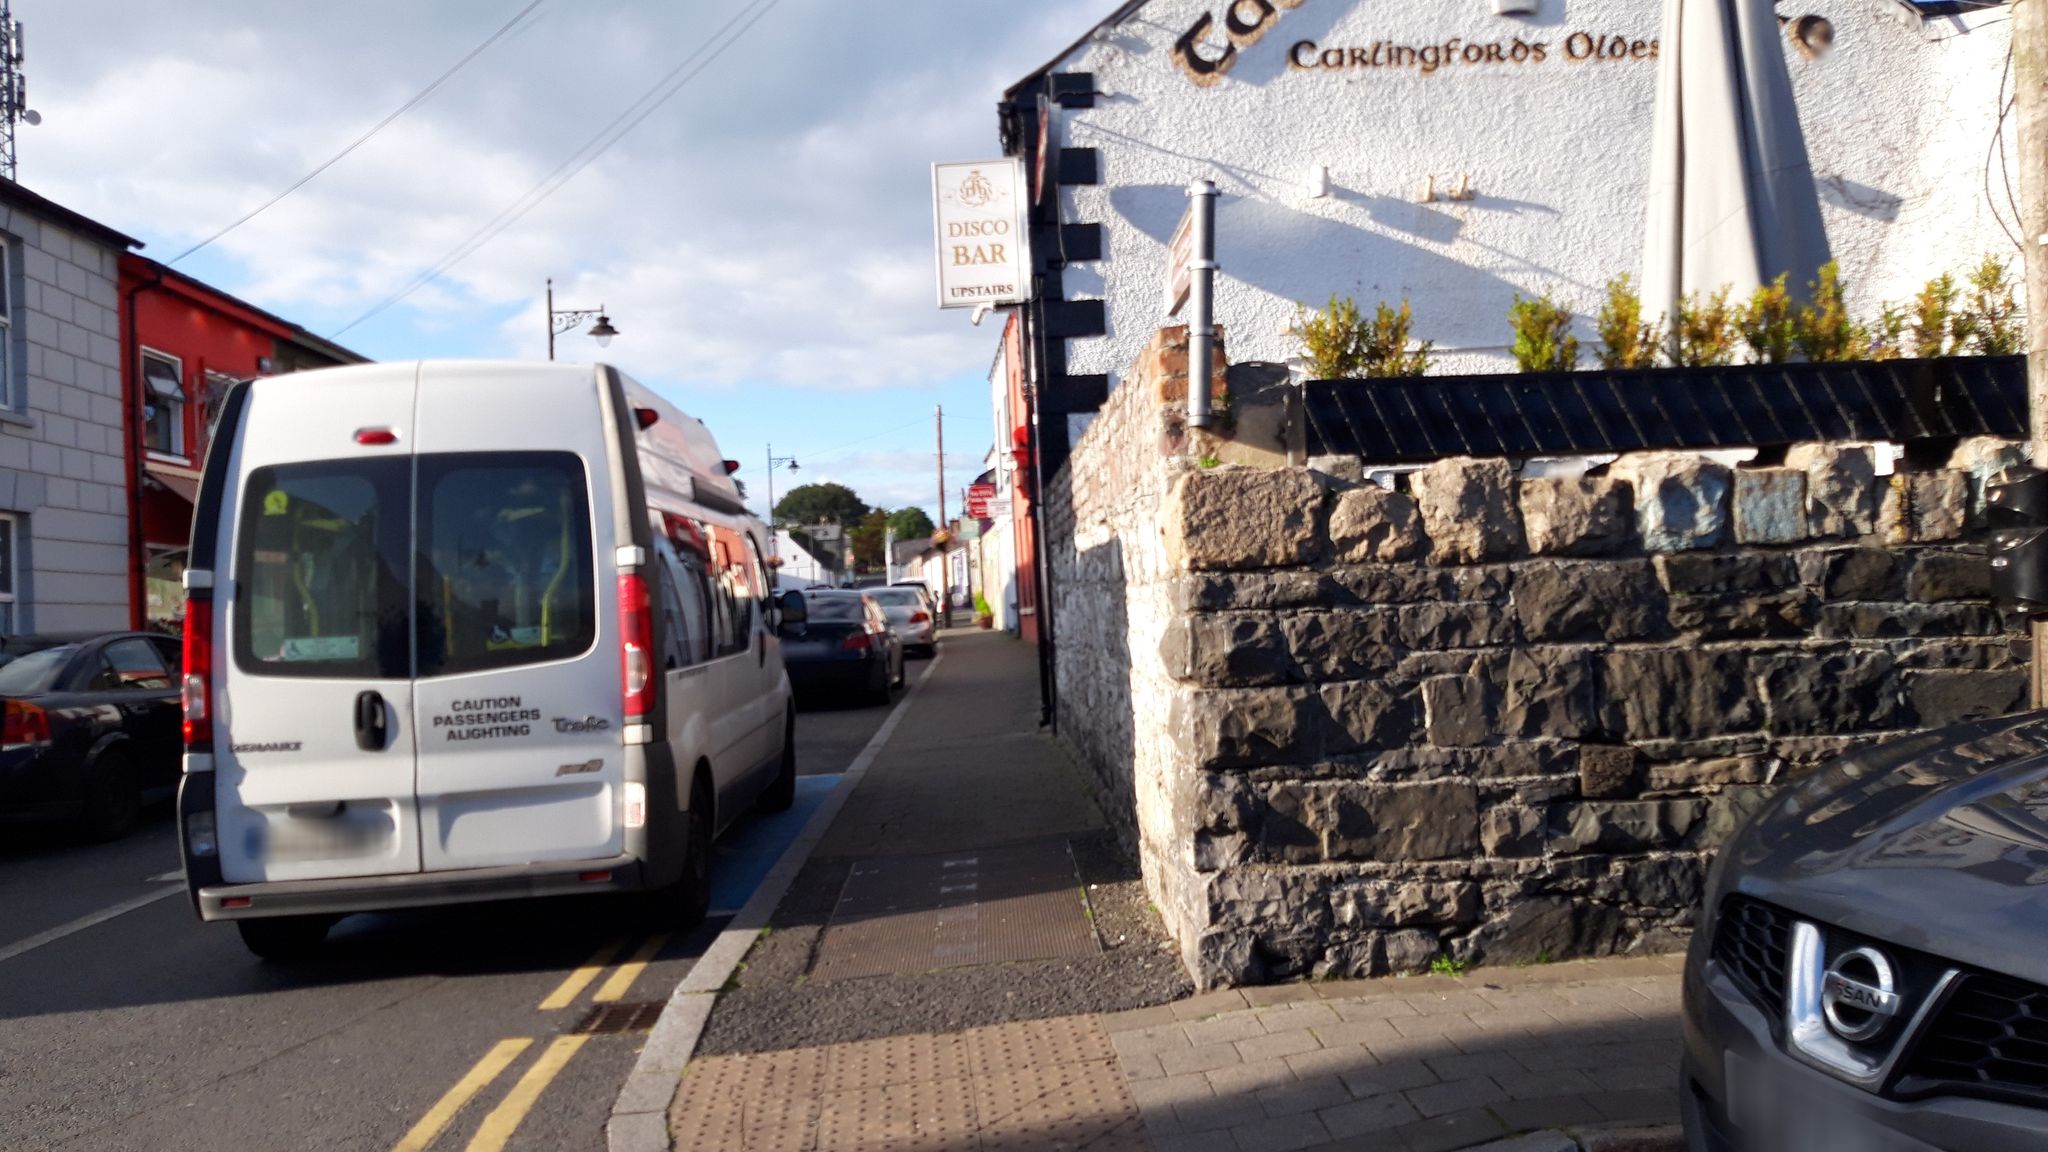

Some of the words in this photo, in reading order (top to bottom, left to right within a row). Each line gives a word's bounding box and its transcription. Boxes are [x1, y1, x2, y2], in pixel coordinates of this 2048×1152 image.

[948, 219, 1009, 238] DISCO
[952, 243, 1007, 266] BAR
[951, 284, 1014, 298] UPSTAIRS
[451, 696, 521, 712] CAUTION
[433, 709, 541, 727] PASSENGERS
[446, 724, 530, 741] ALIGHTING
